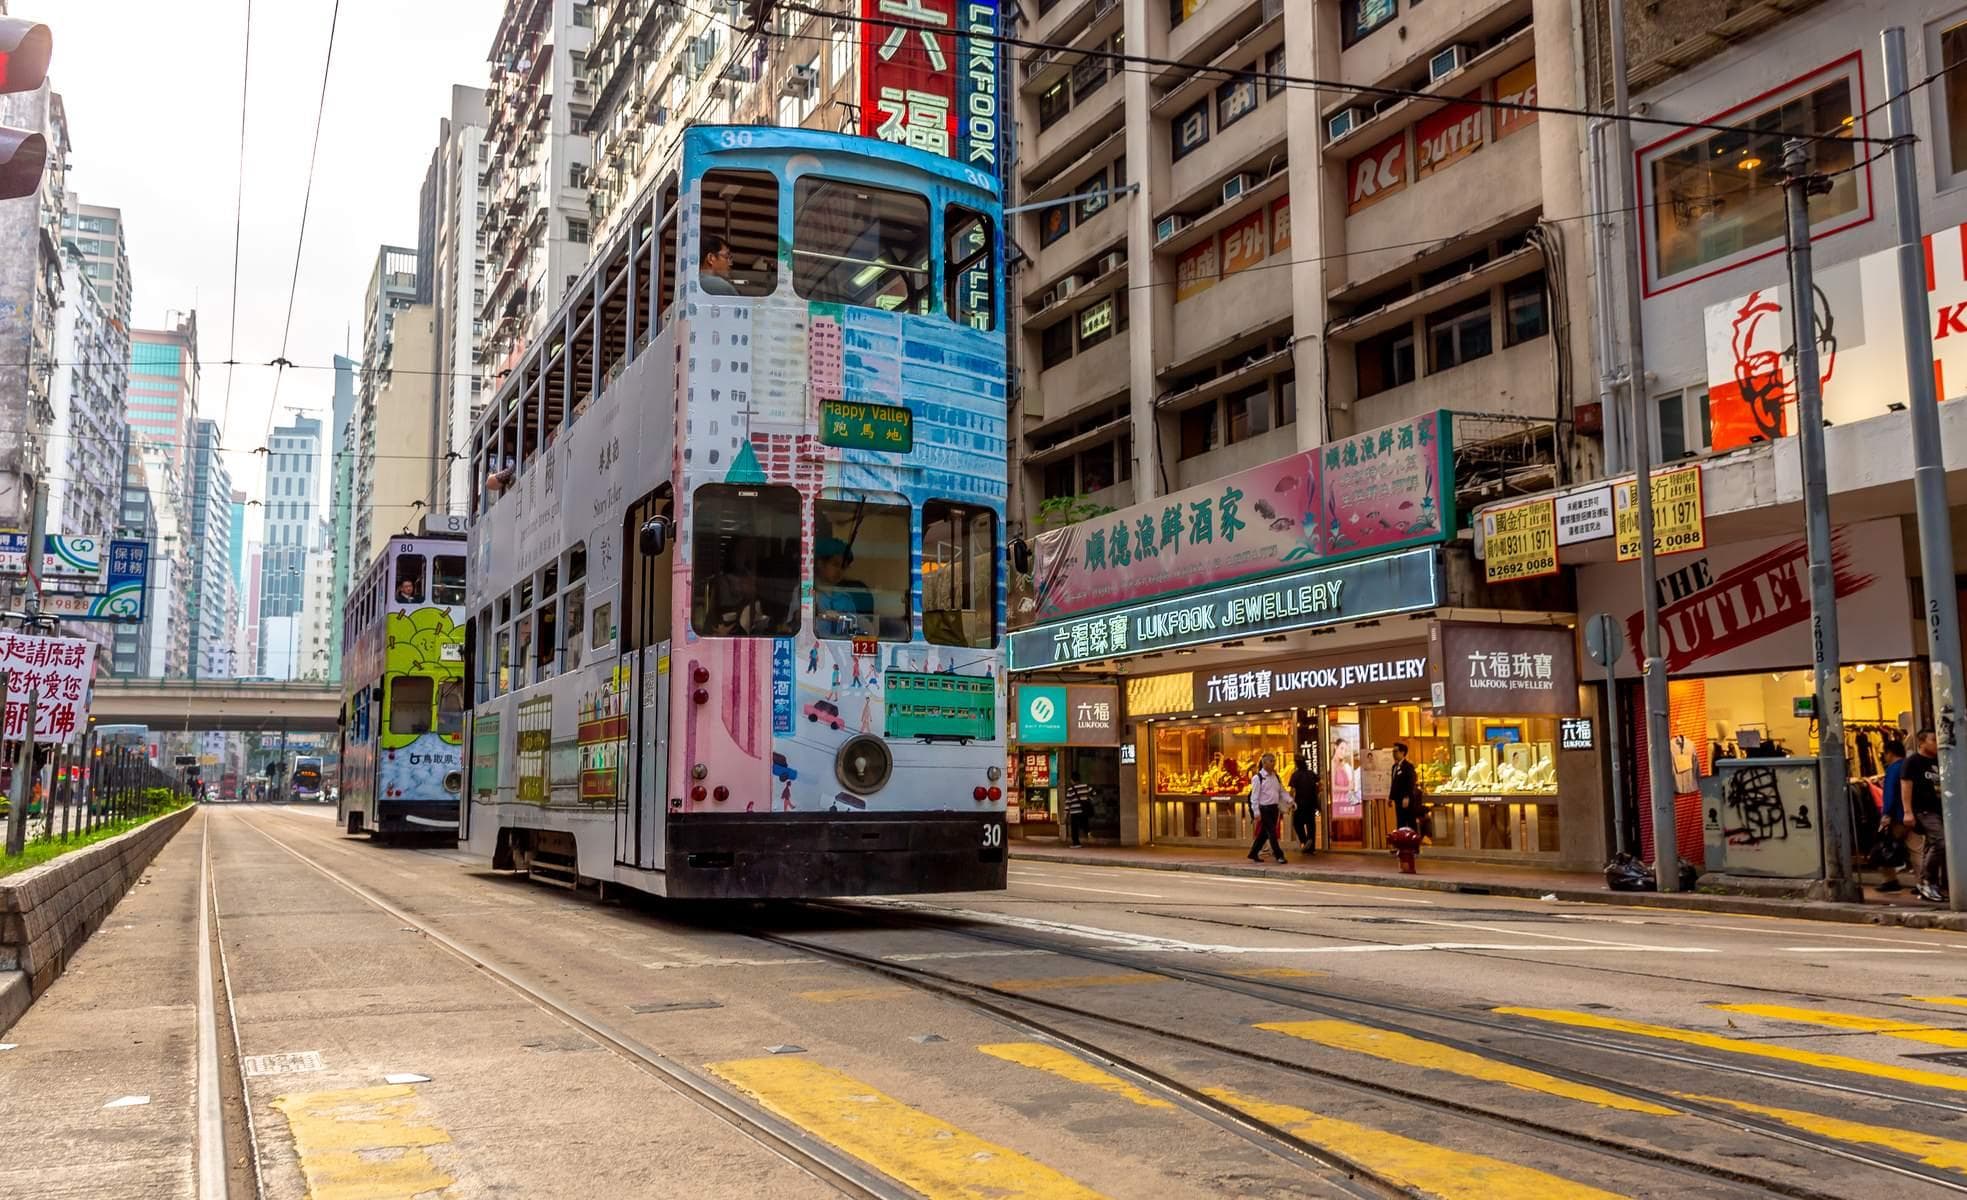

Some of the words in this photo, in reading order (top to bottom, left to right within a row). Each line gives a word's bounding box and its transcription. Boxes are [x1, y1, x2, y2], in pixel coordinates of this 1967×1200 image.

[968, 3, 996, 165] LUKFOOK
[720, 130, 752, 148] 30
[964, 169, 990, 190] 30
[1353, 143, 1403, 202] RC
[824, 402, 866, 421] Happy
[871, 405, 910, 426] Valley
[832, 420, 902, 441] 跑馬地
[1672, 500, 1697, 525] 1971
[400, 543, 414, 553] 80
[1507, 533, 1528, 556] 9311
[1530, 528, 1552, 551] 1971
[1666, 532, 1701, 547] 0088
[1496, 562, 1524, 576] 2692
[1526, 557, 1554, 570] 0088
[1655, 558, 1714, 609] THE
[1054, 614, 1129, 661] 六福珠寶
[1137, 603, 1216, 641] LUKFOOK
[1221, 579, 1343, 627] JEWELLERY
[854, 642, 877, 653] 121
[1468, 650, 1553, 679] 六福珠寶
[1207, 669, 1272, 704] 六福珠寶
[1275, 668, 1338, 692] LUKFOOK
[1339, 657, 1427, 689] JEWELLERY
[1469, 679, 1508, 689] LUKFOOK
[1509, 680, 1554, 691] JEWELLERY
[1077, 702, 1110, 721] 六福
[1077, 721, 1110, 729] LUKFOOK
[1562, 720, 1591, 741] 六福
[983, 824, 1001, 847] 30
